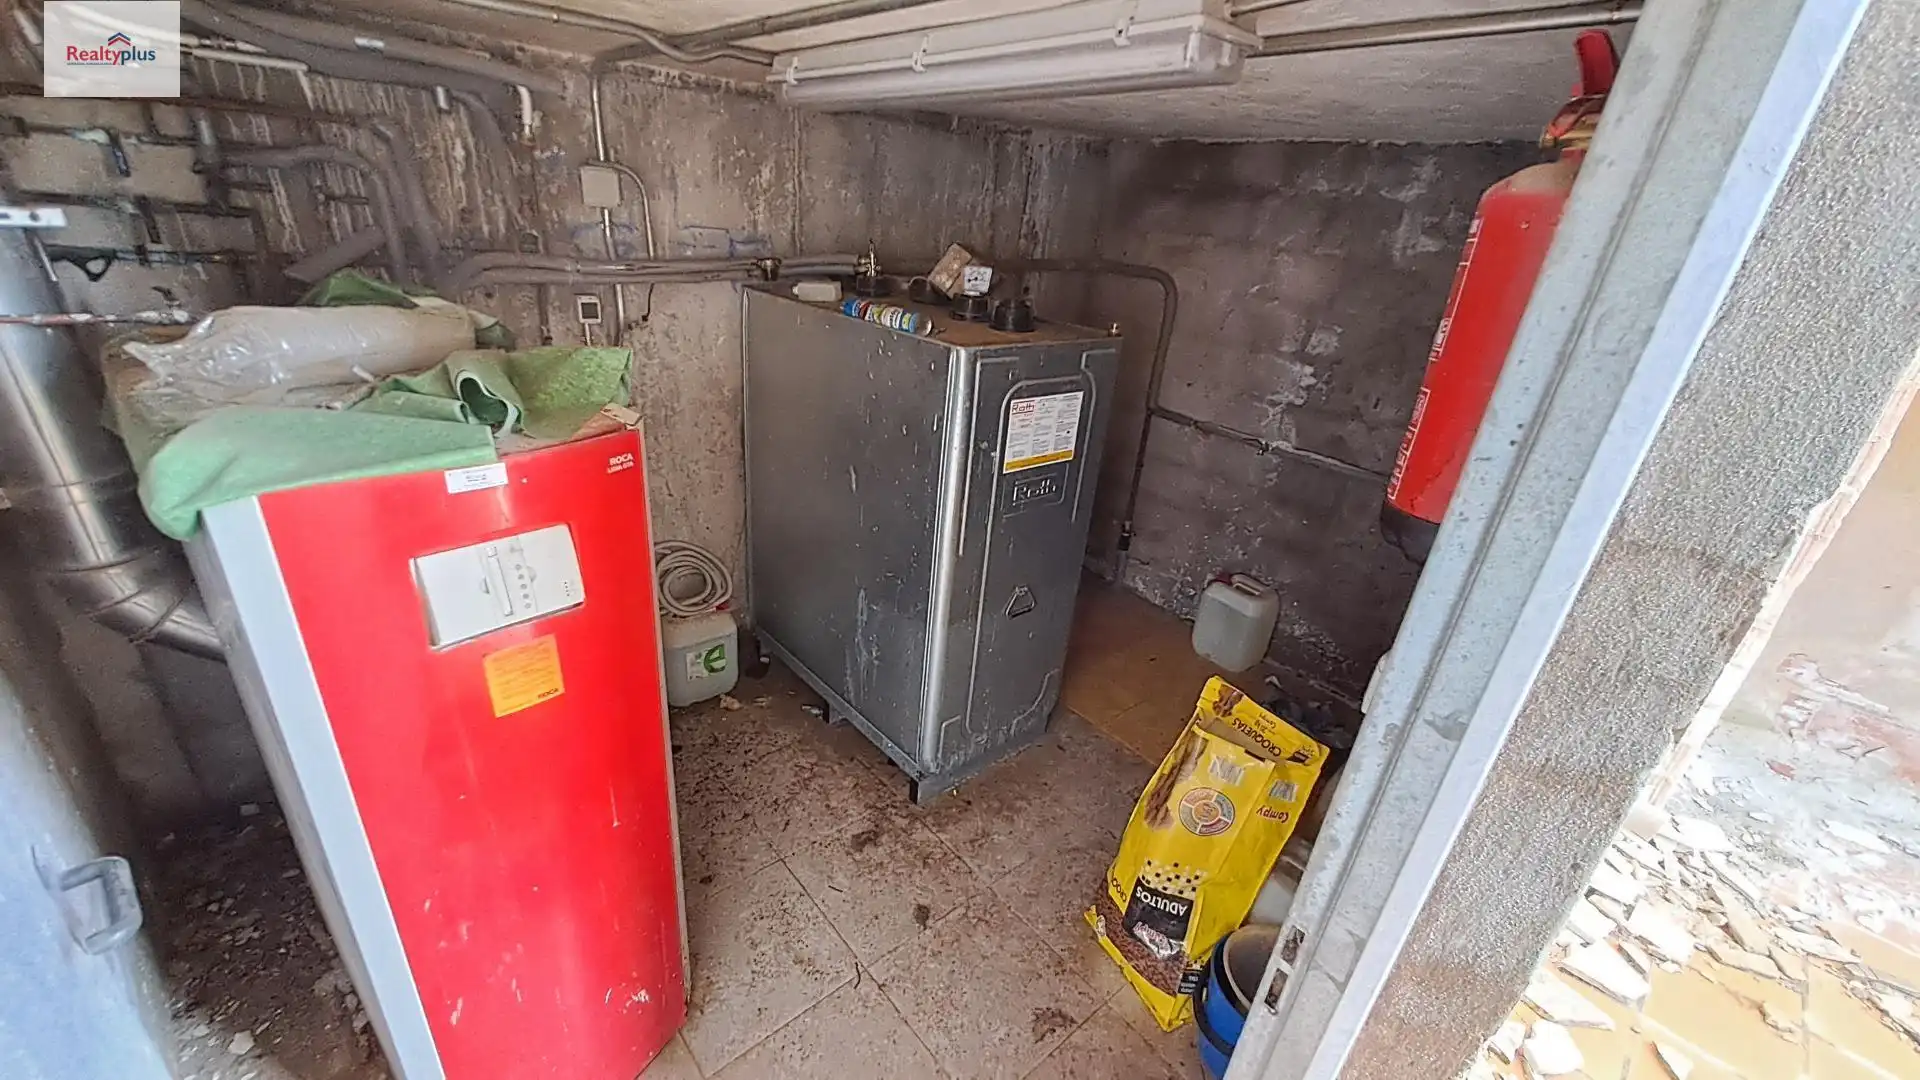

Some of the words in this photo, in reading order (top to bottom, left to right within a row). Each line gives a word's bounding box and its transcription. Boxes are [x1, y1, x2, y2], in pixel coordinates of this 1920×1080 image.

[609, 453, 633, 466] ROCA
[1231, 717, 1282, 757] CROQUETAS
[1255, 804, 1290, 824] Compy
[1135, 886, 1188, 917] ADULTOS
